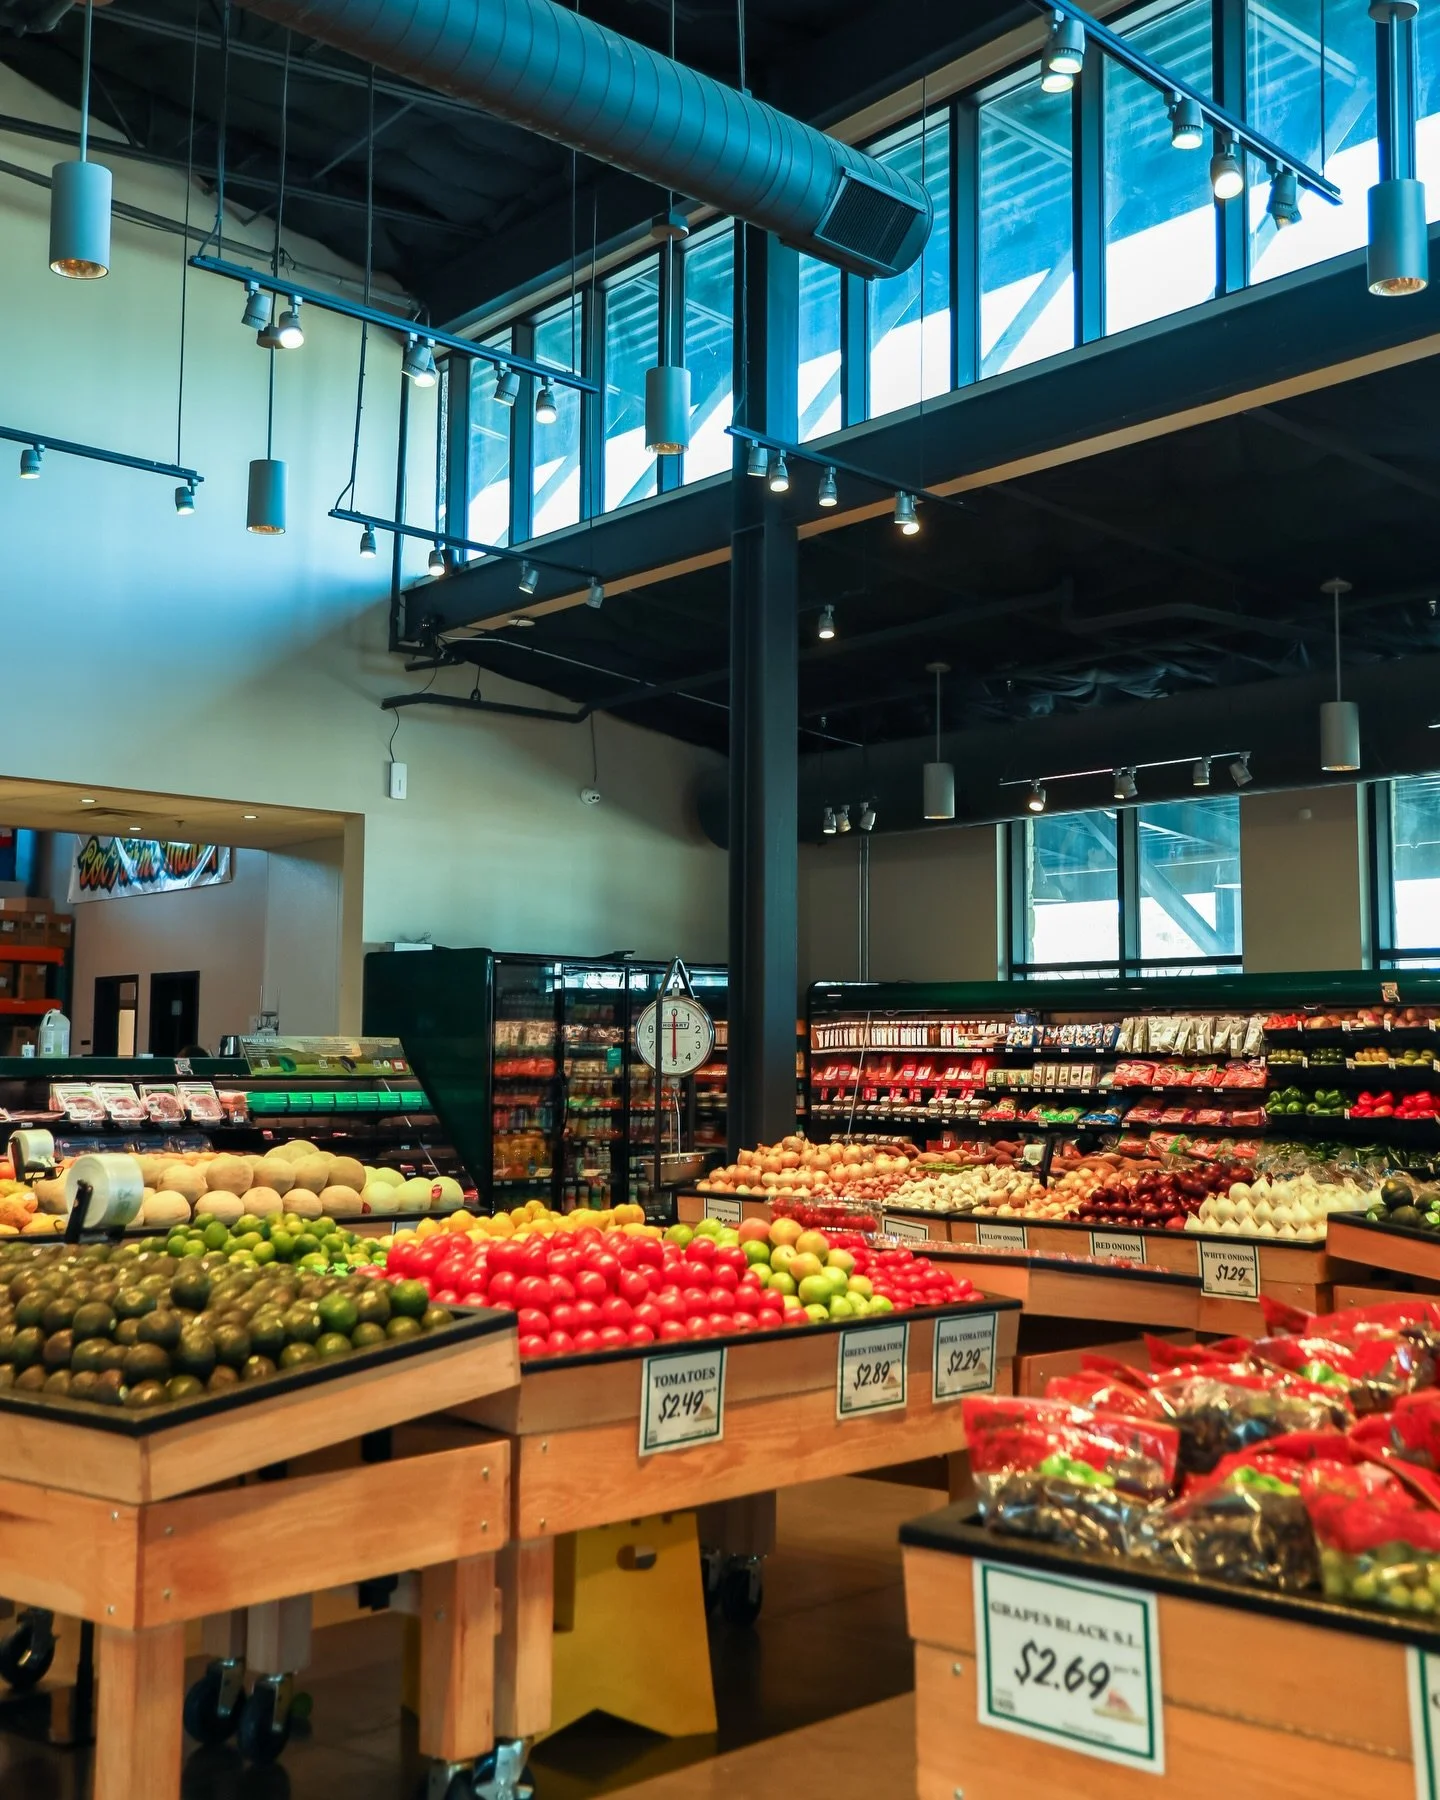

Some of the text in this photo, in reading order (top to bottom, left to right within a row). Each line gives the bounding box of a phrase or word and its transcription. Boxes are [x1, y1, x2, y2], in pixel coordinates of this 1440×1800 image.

[671, 1008, 678, 1016] 0
[686, 1013, 690, 1021] 1
[648, 1025, 654, 1033] 8
[694, 1025, 701, 1034] 2
[648, 1041, 654, 1049] 7
[695, 1041, 701, 1049] 3
[672, 1057, 678, 1066] 5
[685, 1053, 691, 1061] 4
[981, 1233, 1002, 1241] YELLOW
[1095, 1241, 1141, 1252] RED ONIONS
[1203, 1251, 1255, 1263] WHITE ONIONS
[940, 1330, 992, 1345] ROMA TOMATOES
[845, 1341, 902, 1358] GREEN TOMATOES
[654, 1366, 716, 1389] TOMATOES
[853, 1360, 890, 1391] $2.89
[658, 1389, 704, 1424] $2.49
[990, 1601, 1053, 1629] GRAPES
[1054, 1616, 1109, 1643] BLACK
[1014, 1640, 1111, 1700] $2.69
